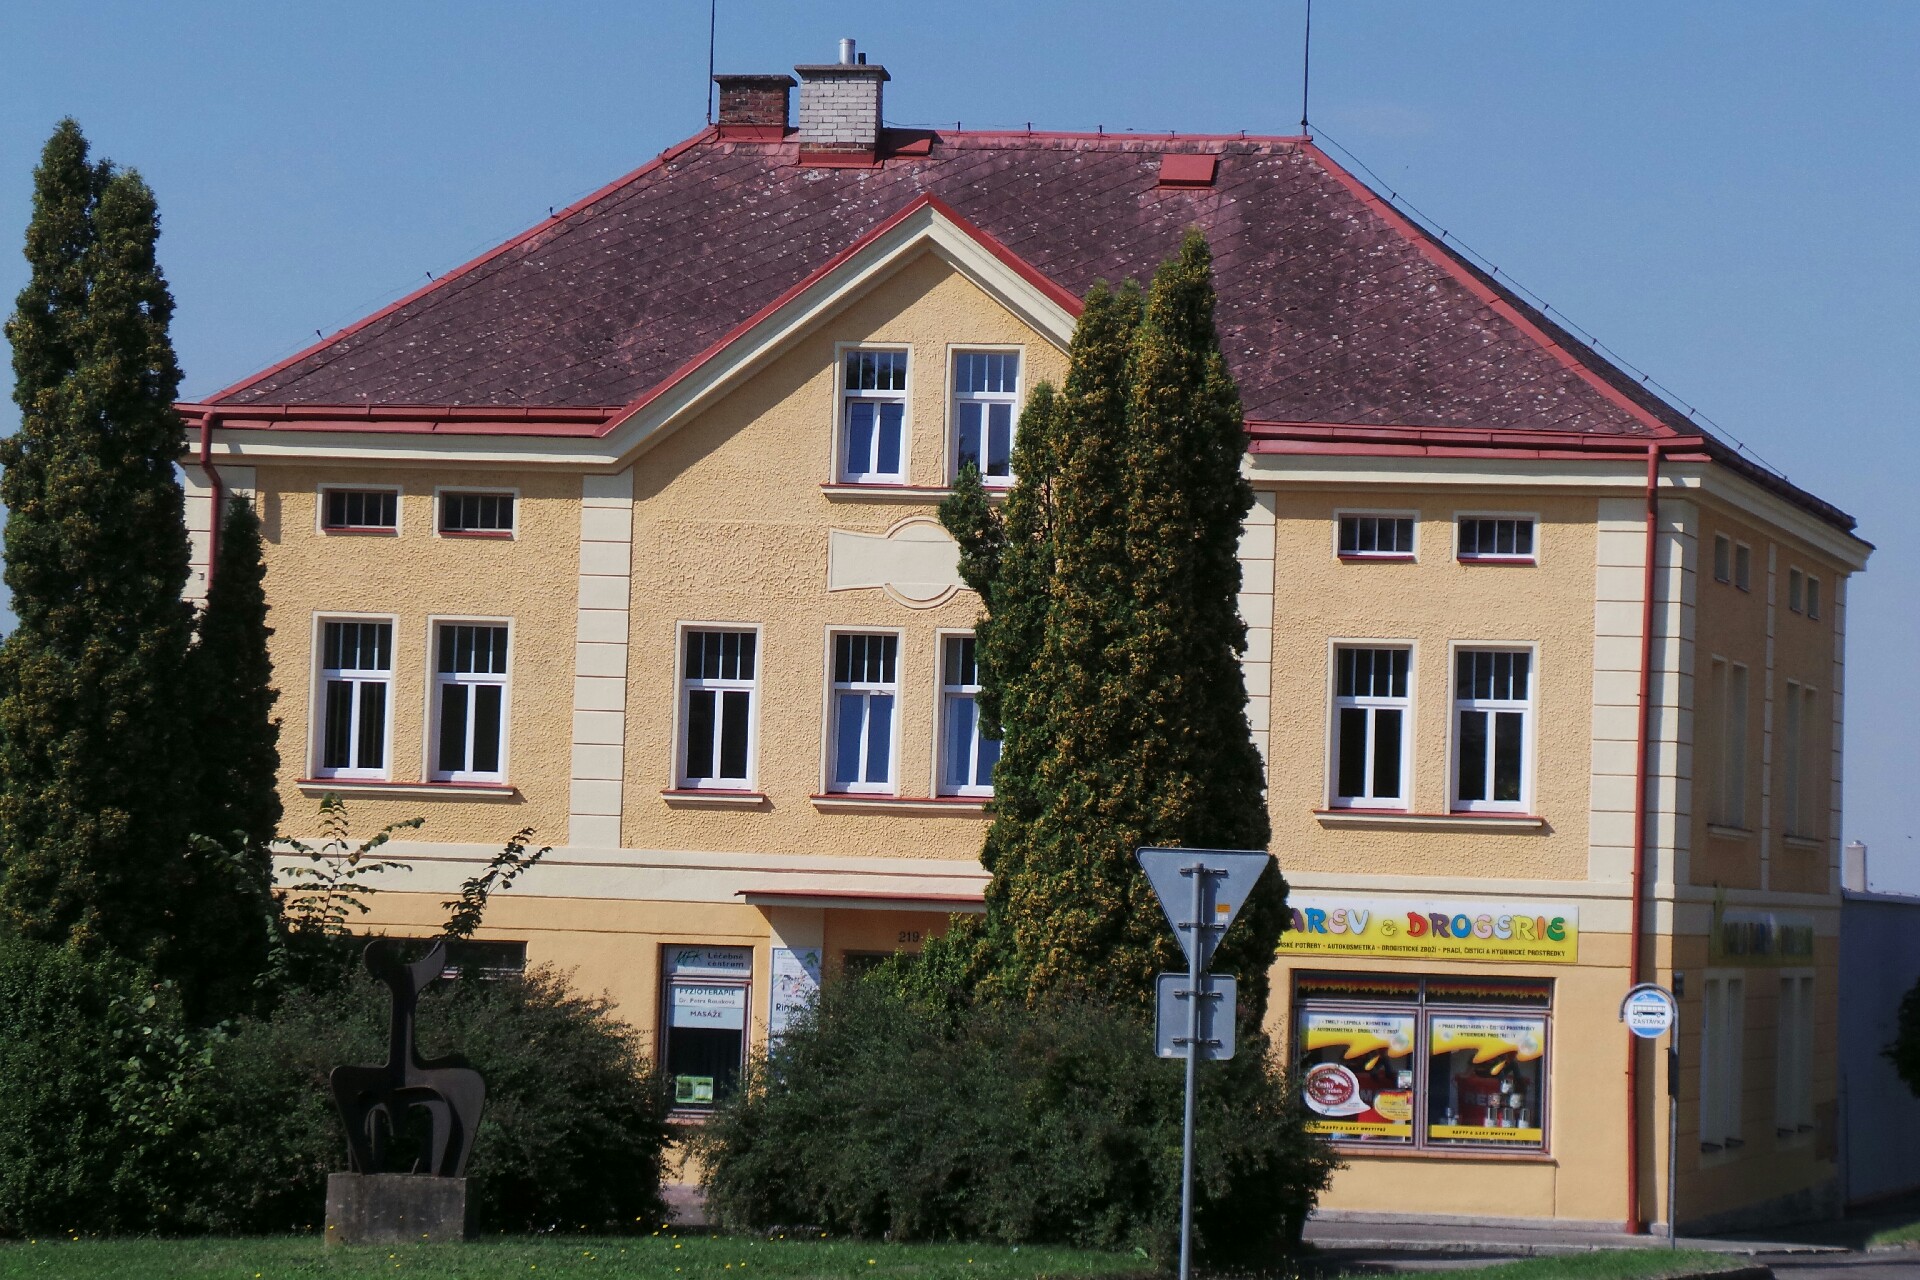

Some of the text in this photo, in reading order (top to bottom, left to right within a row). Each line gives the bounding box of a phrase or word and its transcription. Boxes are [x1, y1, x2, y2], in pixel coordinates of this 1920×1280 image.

[1289, 907, 1566, 942] AREV & DROGERIE
[898, 930, 920, 943] 219
[1295, 941, 1322, 950] POTŘEBY
[1327, 943, 1376, 951] AUTOKOSMETIKA
[1381, 944, 1419, 952] DROGISTICKÉ
[1420, 945, 1437, 953] ZBOŽÍ
[1491, 948, 1526, 956] HYGIENICKÉ
[707, 951, 744, 960] Léčebné
[679, 987, 736, 997] FYZIOTERAPIE
[690, 1010, 722, 1018] MASÁŽE
